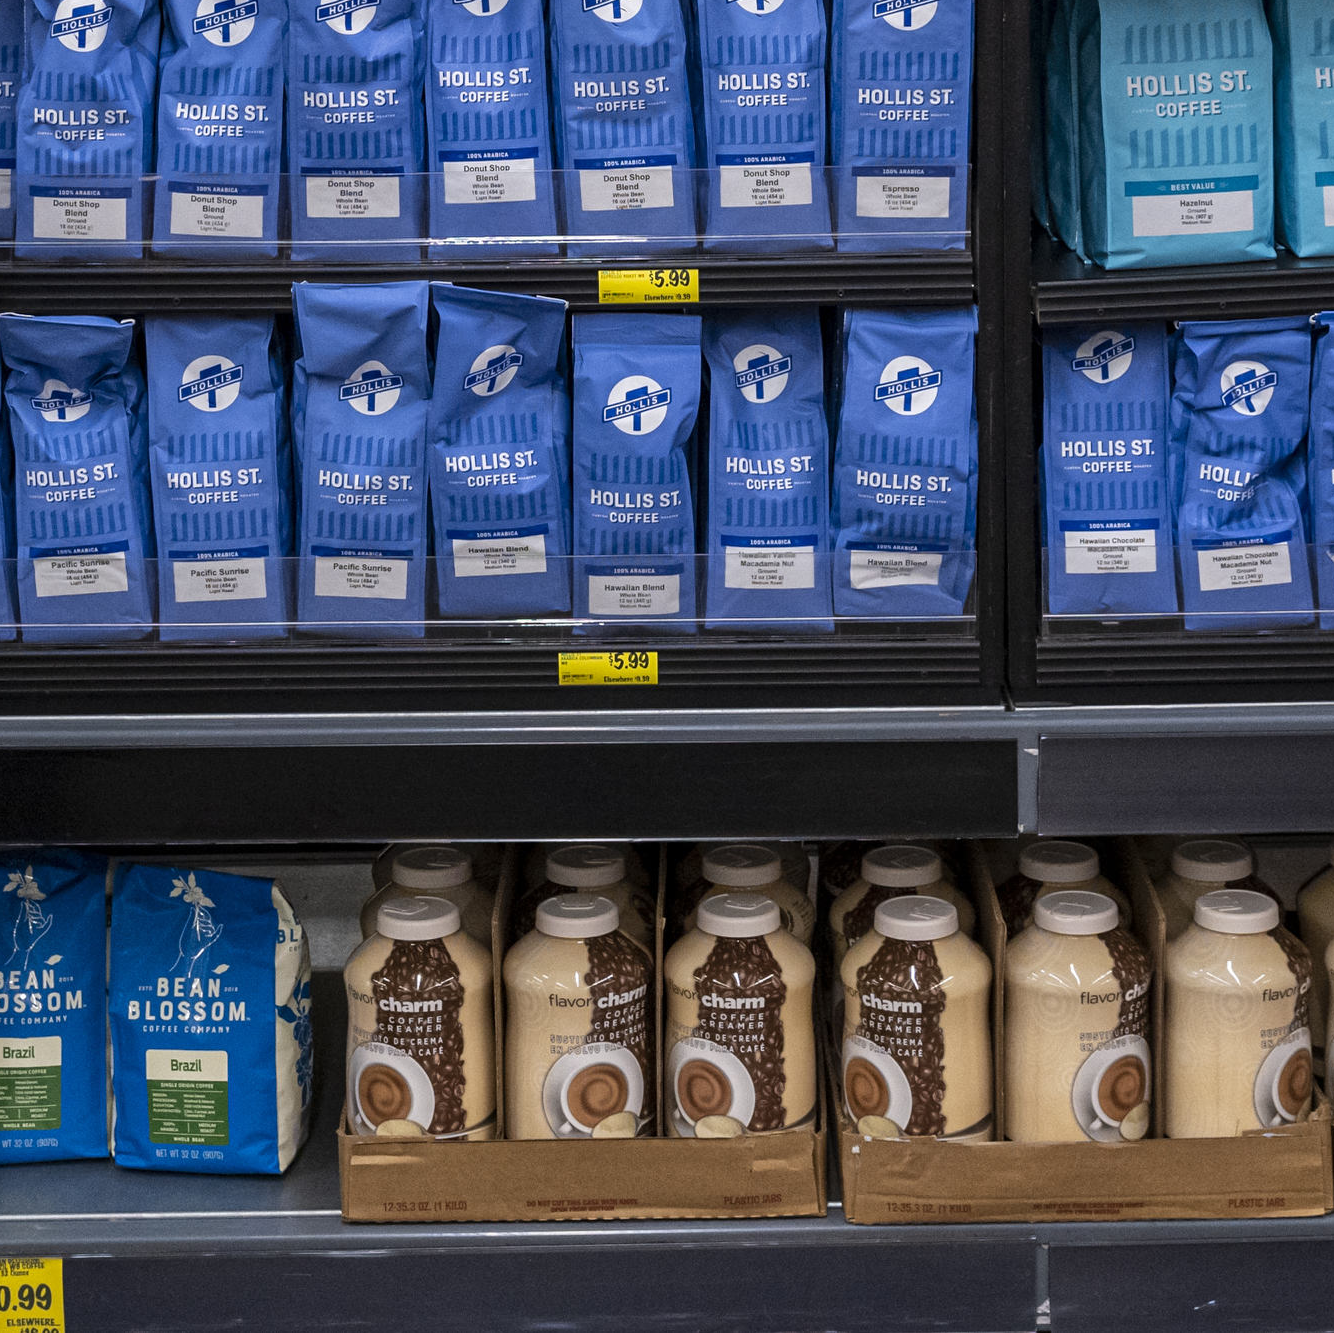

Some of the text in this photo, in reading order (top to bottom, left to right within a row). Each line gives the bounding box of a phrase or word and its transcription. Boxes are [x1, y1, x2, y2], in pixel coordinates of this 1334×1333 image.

[744, 169, 790, 178] Donut Shop
[167, 467, 263, 490] HOLLIS ST.
[219, 568, 249, 576] Sunrise
[608, 652, 649, 670] $5.99
[156, 977, 221, 998] BEAN
[549, 984, 647, 1010] flavor charm
[128, 1000, 246, 1021] BLOSSOM
[379, 996, 443, 1013] charm
[21, 1015, 68, 1025] COMPANY
[389, 1016, 442, 1024] COFFEE
[379, 1024, 442, 1033] CREAMER
[3, 1046, 35, 1059] Brazil
[170, 1059, 202, 1072] Brazil
